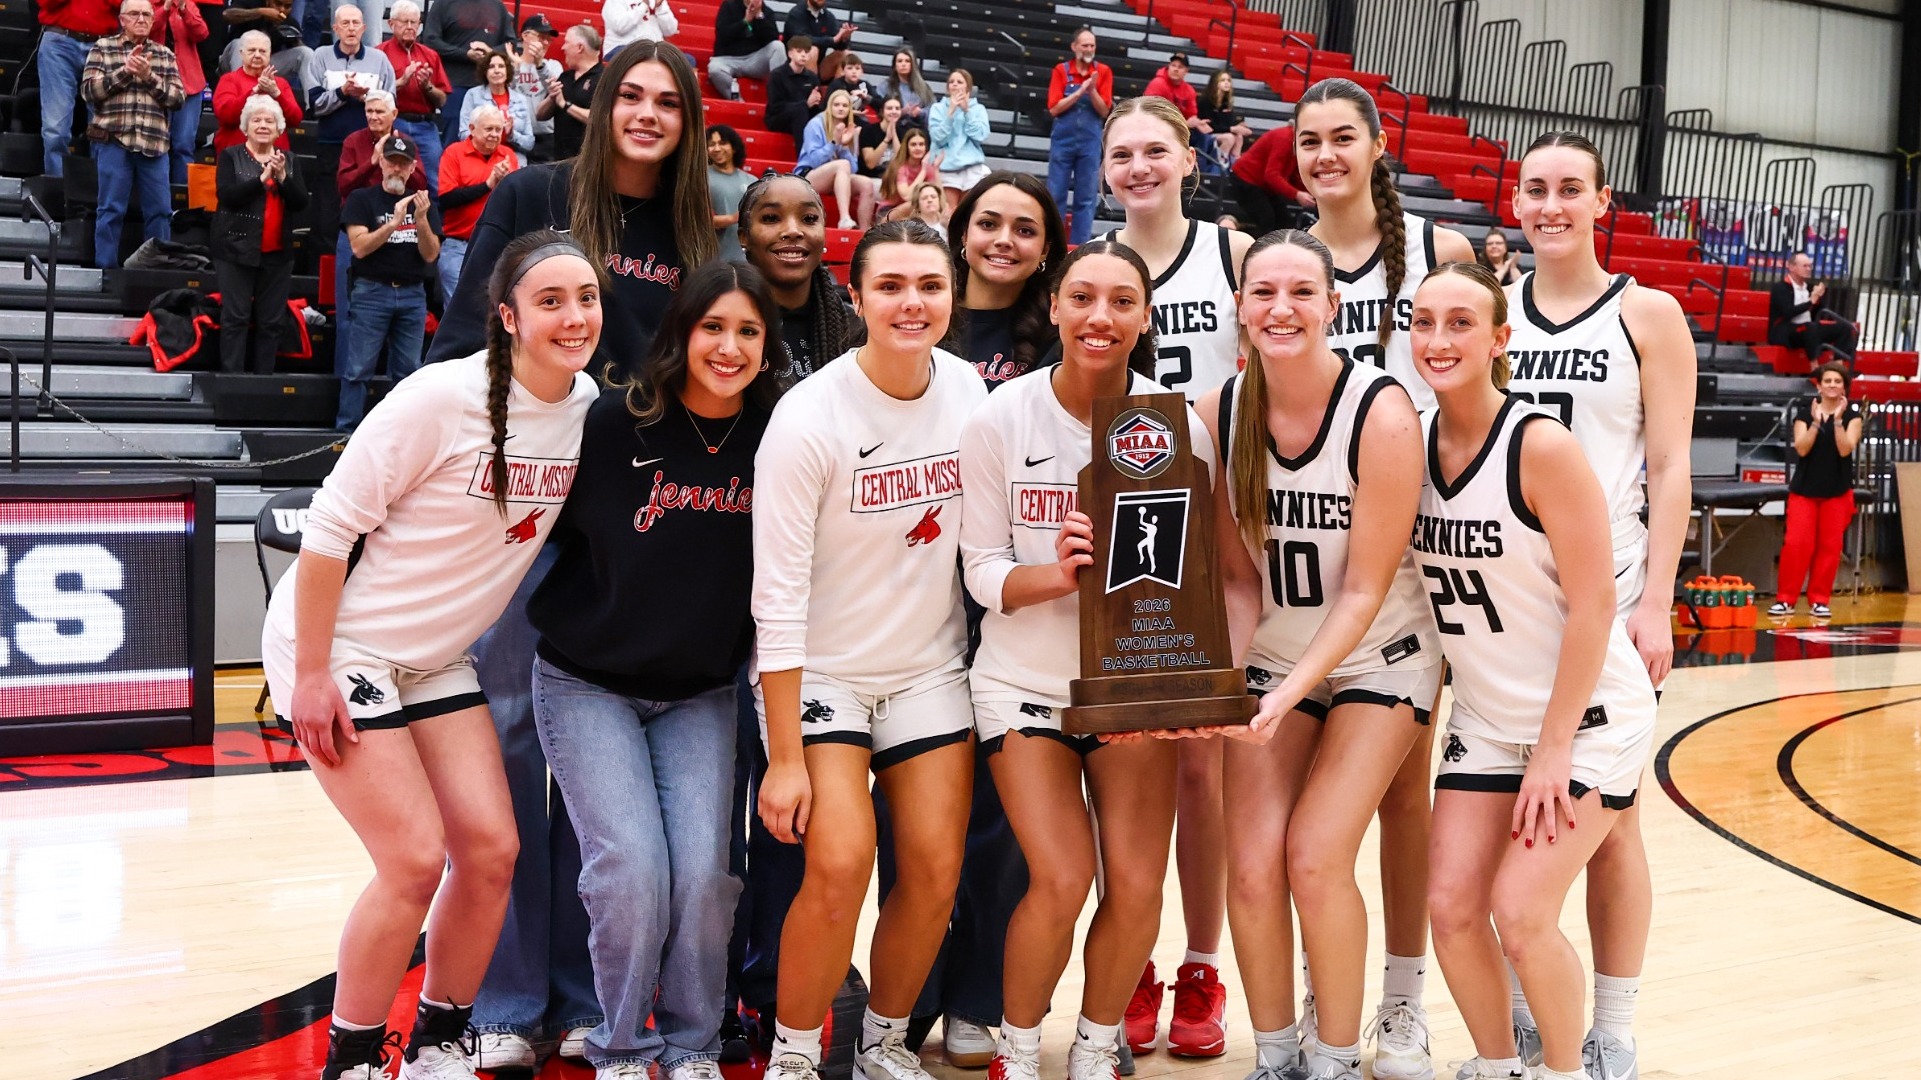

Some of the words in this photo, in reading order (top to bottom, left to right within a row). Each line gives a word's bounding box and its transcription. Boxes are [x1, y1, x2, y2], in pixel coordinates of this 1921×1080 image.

[1115, 434, 1169, 453] MIAA
[633, 470, 754, 533] jennie
[861, 466, 922, 507] CENTRAL
[1264, 488, 1352, 531] NNIES
[1410, 513, 1504, 559] ENNIES
[1263, 538, 1324, 609] 10
[0, 543, 126, 664] S
[1134, 598, 1171, 613] 2026
[1421, 564, 1505, 636] 24
[1115, 633, 1195, 651] WOMEN'S
[1132, 616, 1176, 632] MIAA
[1102, 651, 1211, 671] BASKETBALL
[1591, 712, 1601, 721] M
